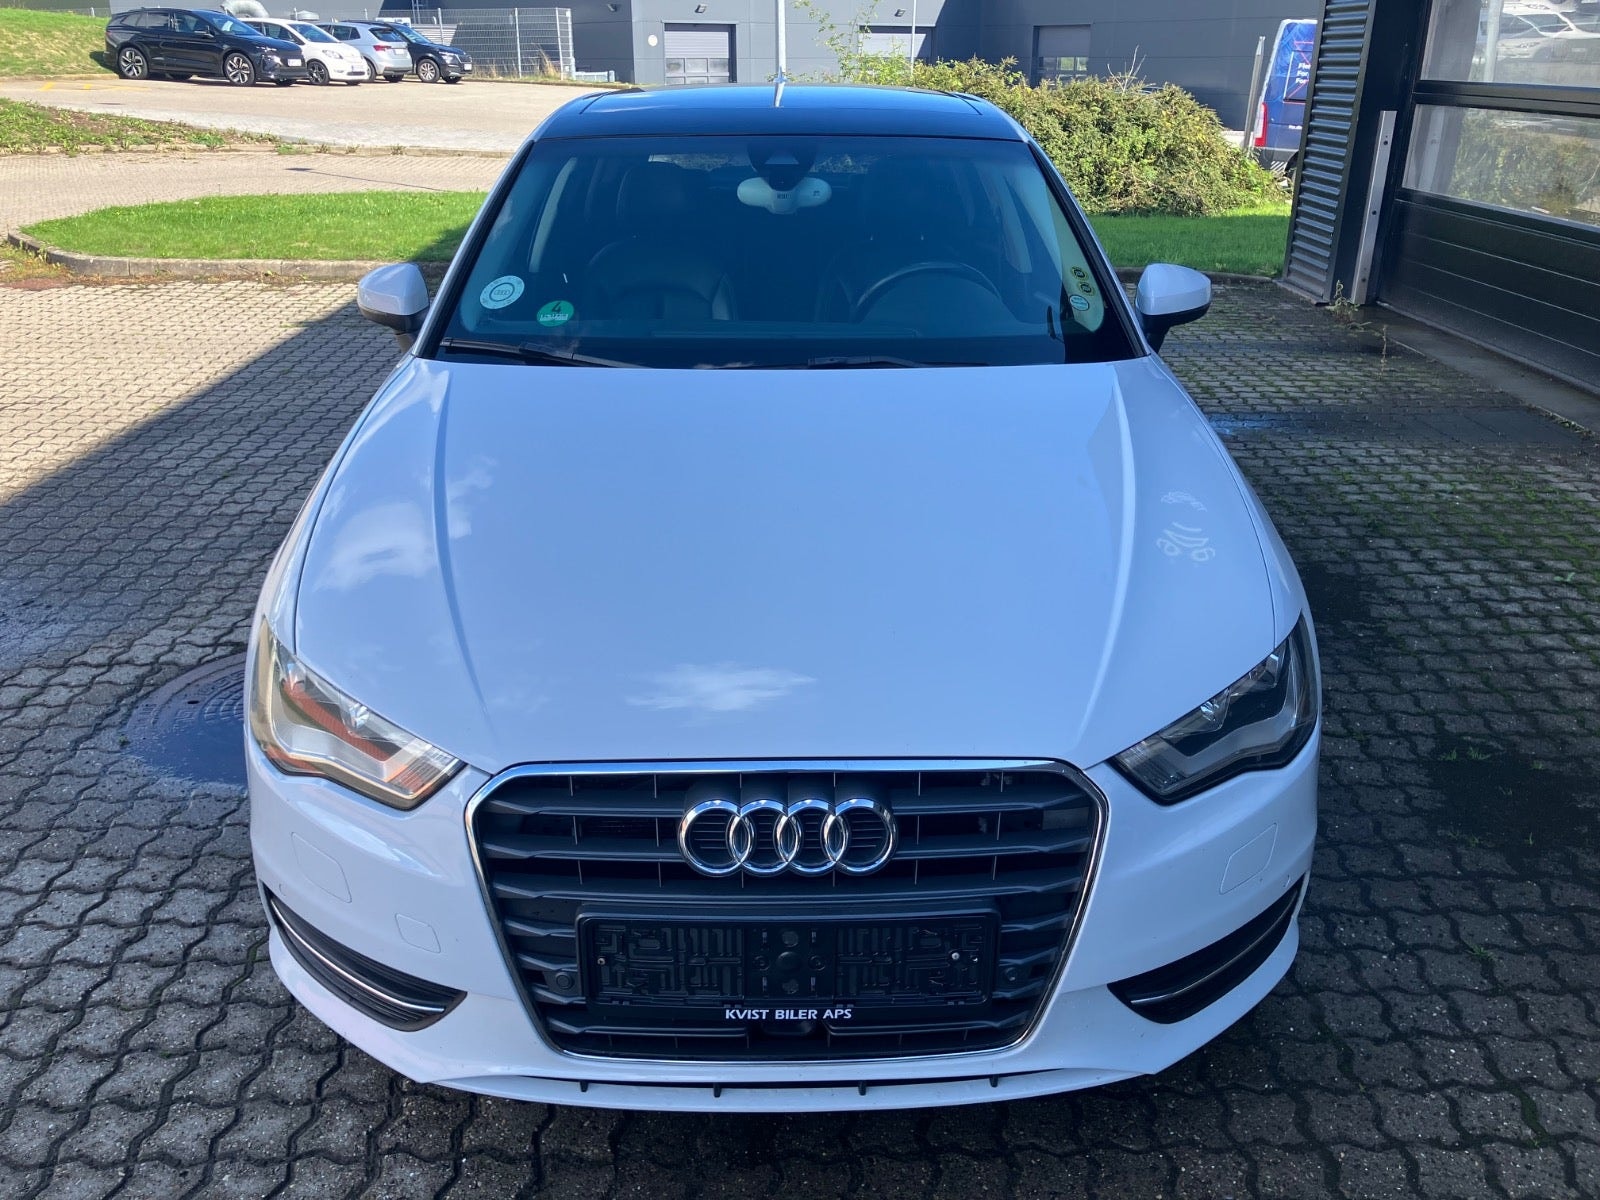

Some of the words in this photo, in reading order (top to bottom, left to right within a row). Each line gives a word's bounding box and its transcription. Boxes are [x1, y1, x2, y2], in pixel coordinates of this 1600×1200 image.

[551, 301, 561, 313] 4
[725, 1009, 769, 1020] KVIST
[775, 1009, 817, 1020] BILER
[823, 1008, 852, 1019] APS
